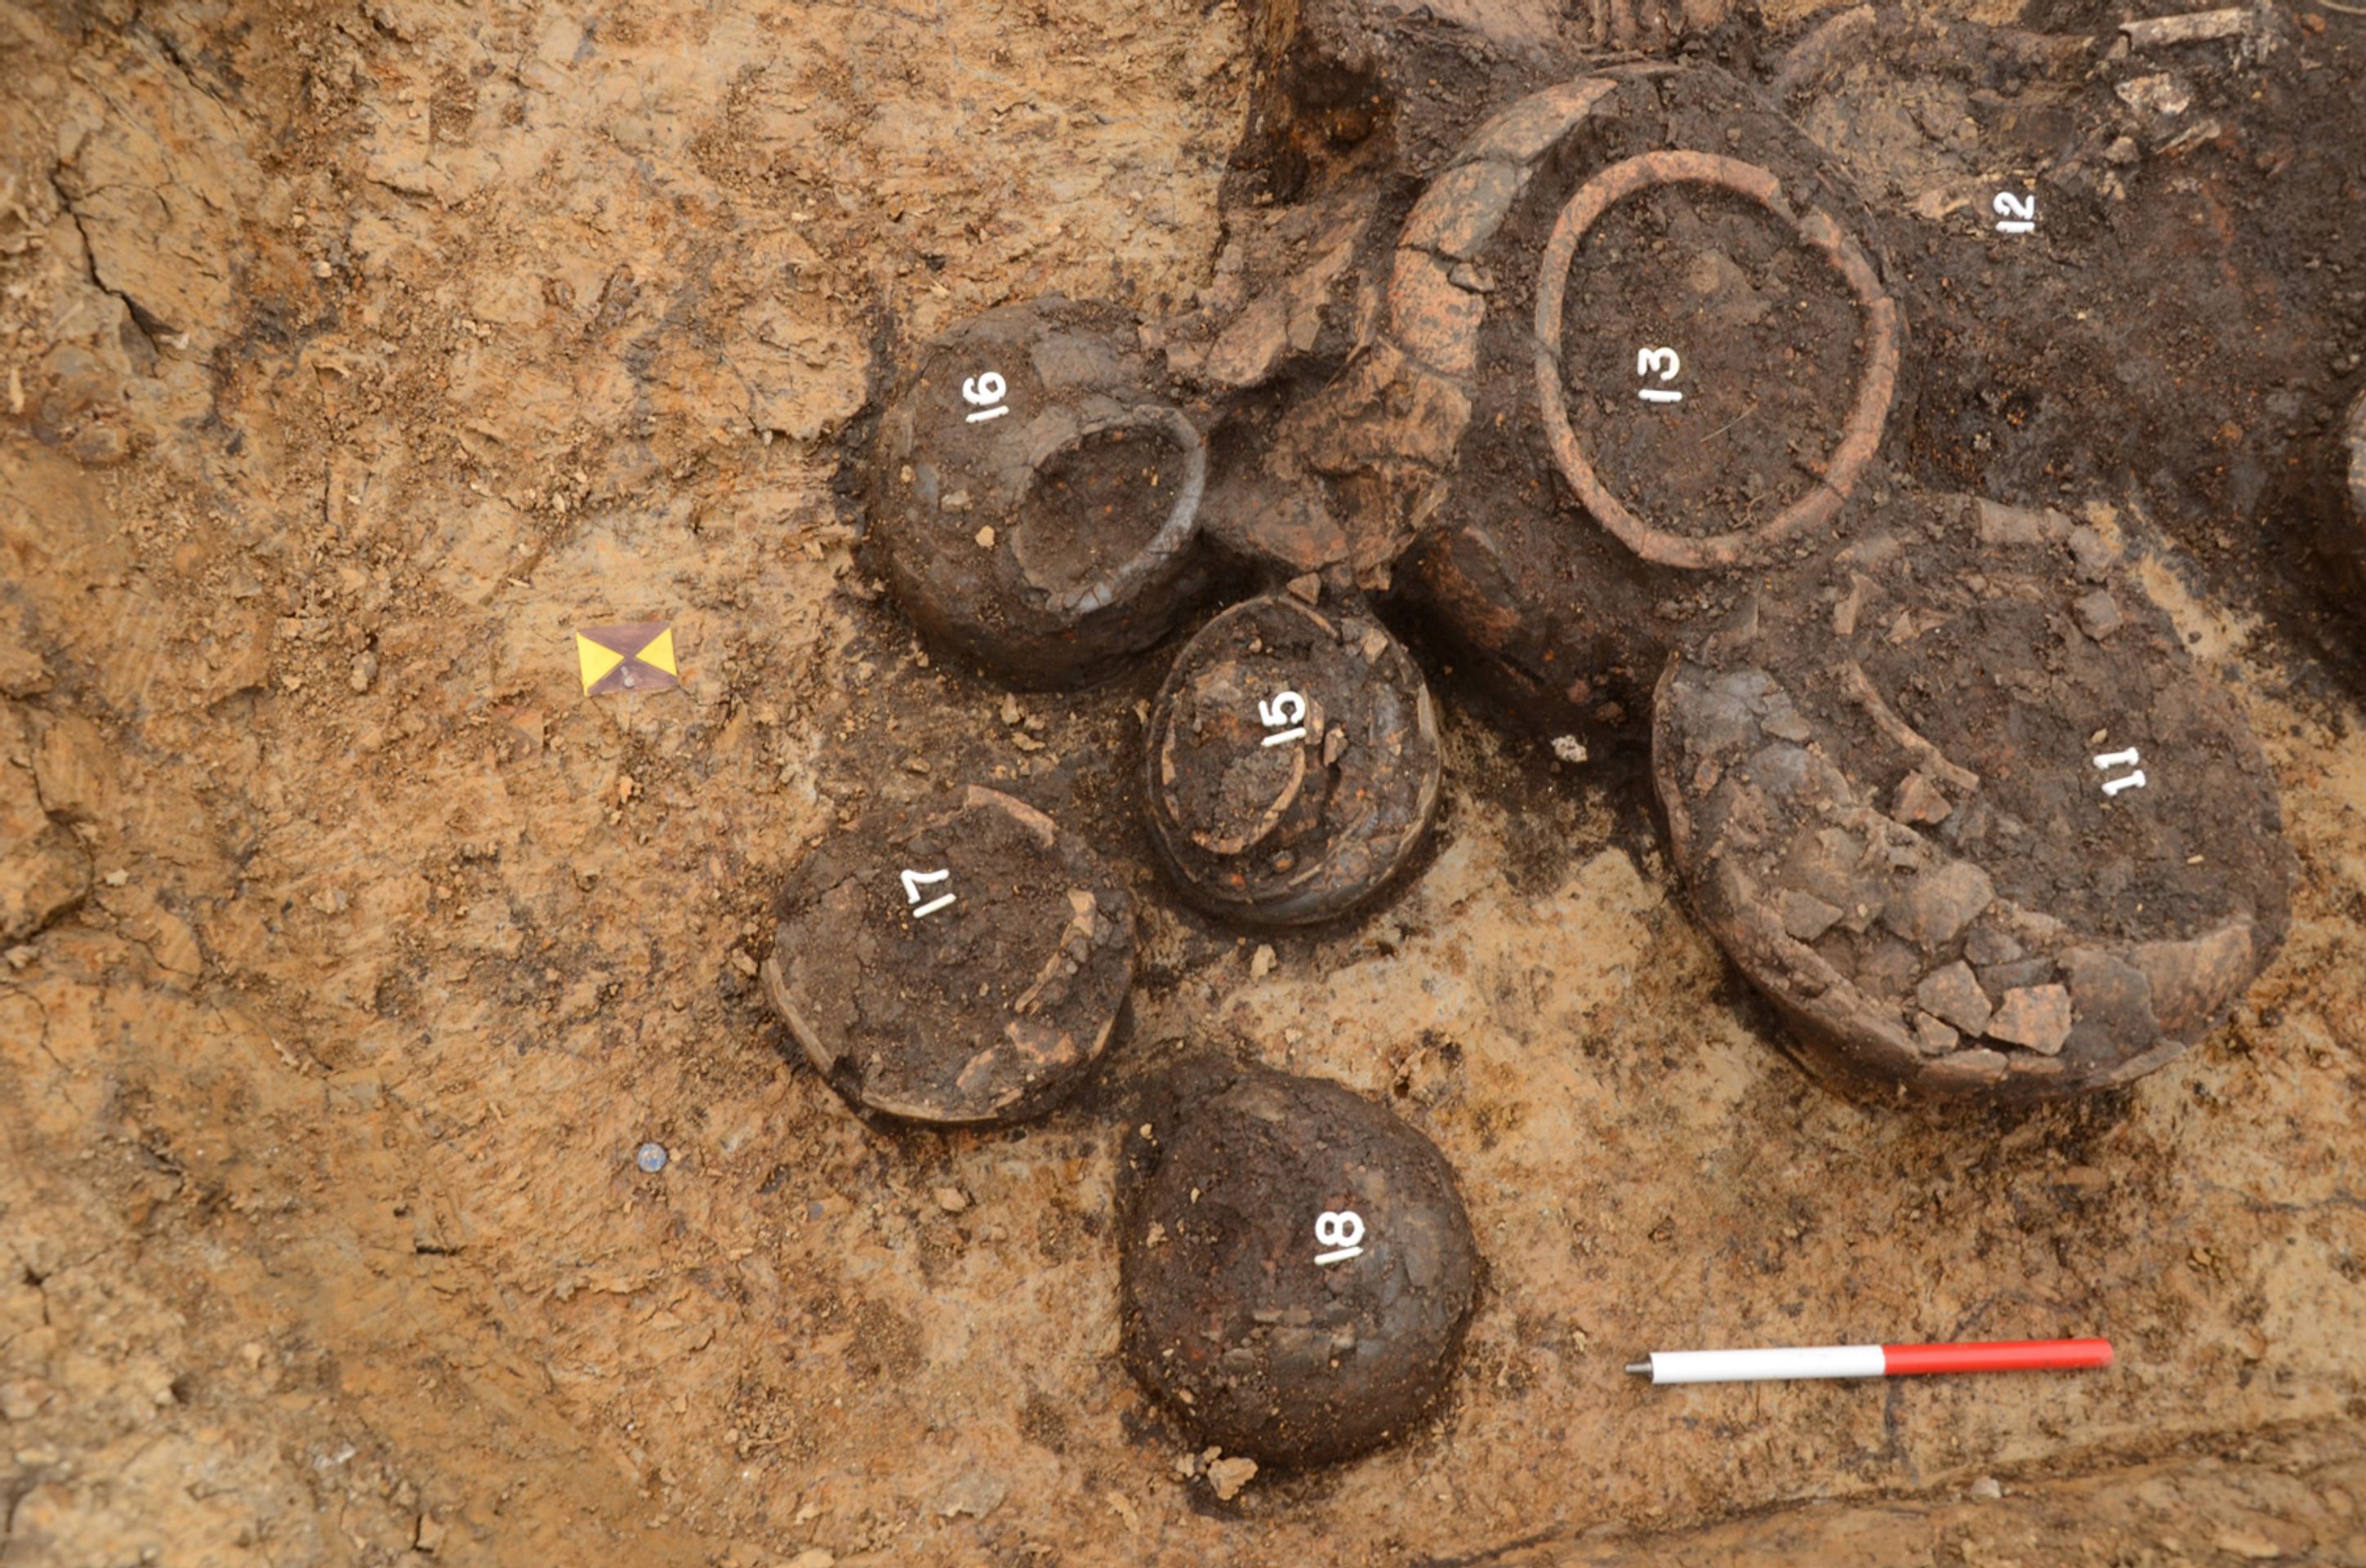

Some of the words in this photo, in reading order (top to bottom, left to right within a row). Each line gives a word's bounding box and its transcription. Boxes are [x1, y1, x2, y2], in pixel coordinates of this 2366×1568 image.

[1994, 192, 2035, 234] 12
[962, 371, 1009, 423] 16
[1637, 347, 1682, 402] 13
[1259, 691, 1307, 747] 15
[2093, 746, 2146, 795] 11
[901, 868, 956, 917] 17
[1314, 1210, 1366, 1265] 18
